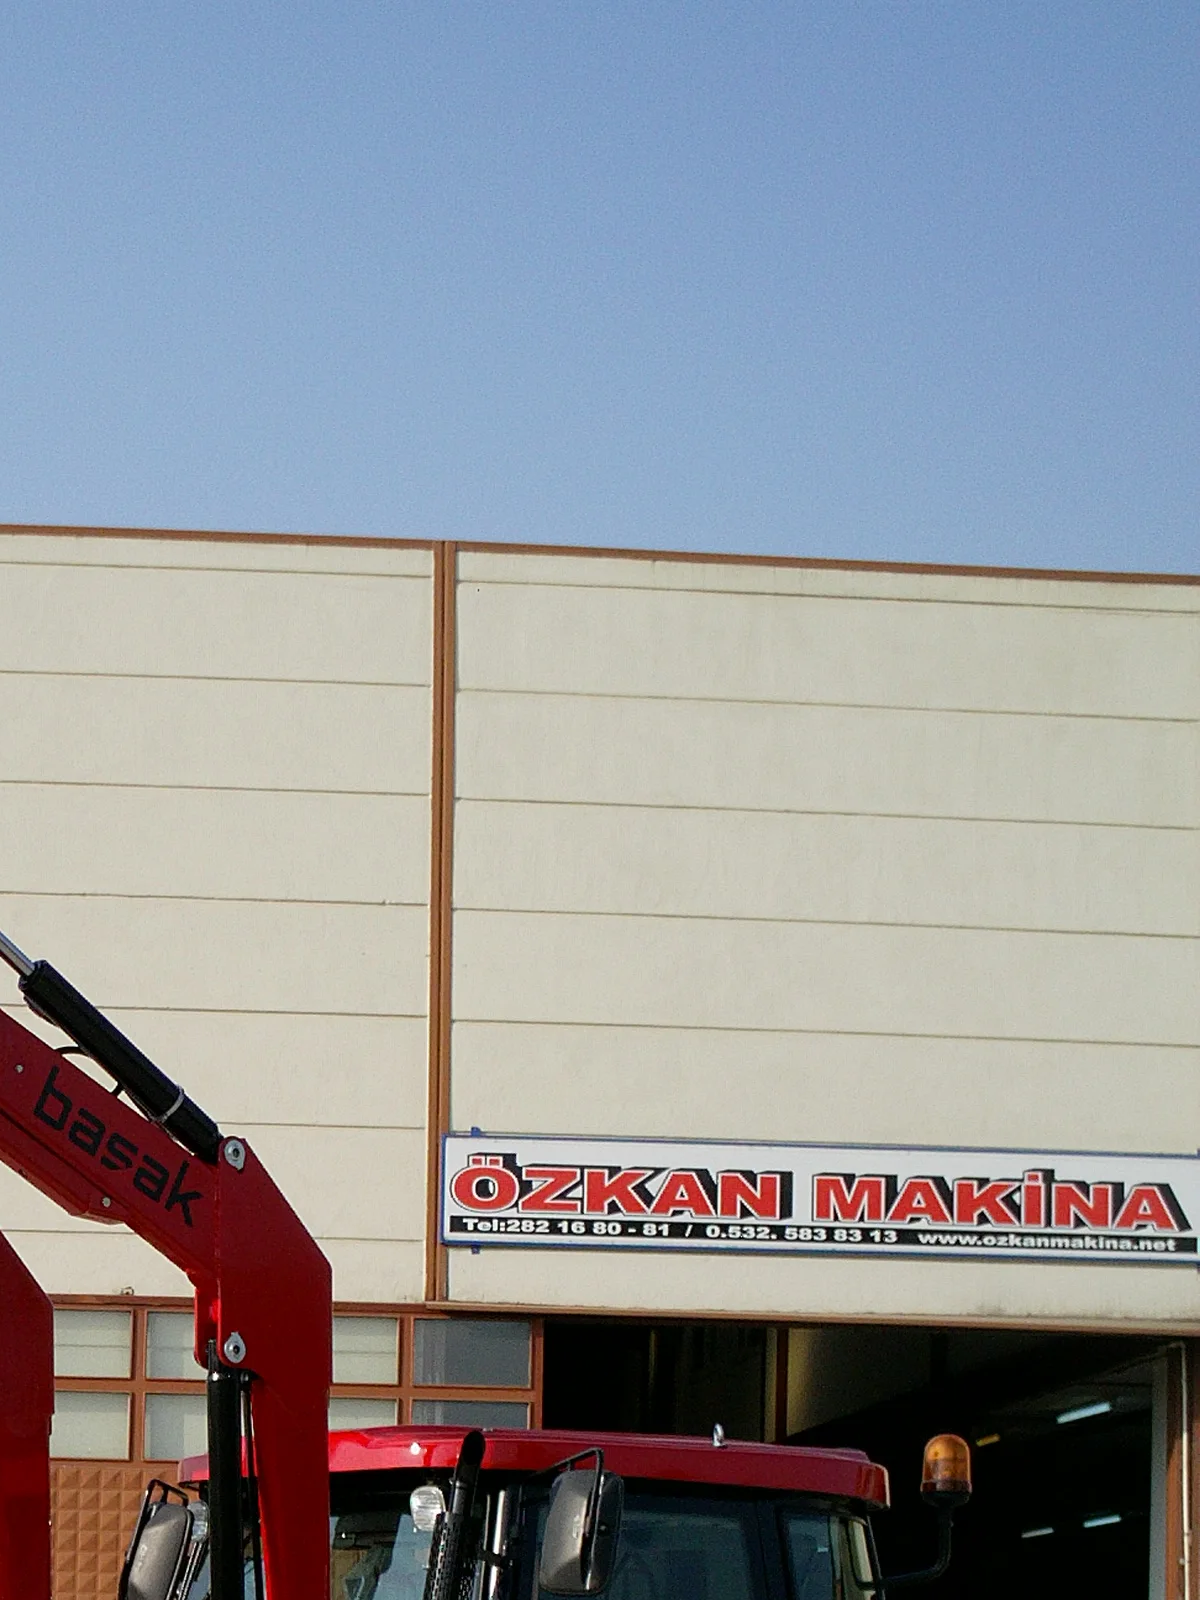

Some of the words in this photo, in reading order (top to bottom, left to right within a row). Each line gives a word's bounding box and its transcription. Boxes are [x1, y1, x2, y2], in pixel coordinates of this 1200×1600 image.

[33, 1066, 203, 1227] basak
[450, 1153, 792, 1221] ÖZKAN
[812, 1169, 1192, 1232] MAKİNA
[463, 1217, 550, 1233] Tel:282
[557, 1219, 585, 1234] 16
[593, 1221, 621, 1236] 80
[642, 1222, 670, 1237] 81
[784, 1226, 828, 1241] 583
[833, 1227, 863, 1242] 83
[869, 1229, 898, 1243] 13
[917, 1232, 1176, 1252] www.ozkanmakina.net
